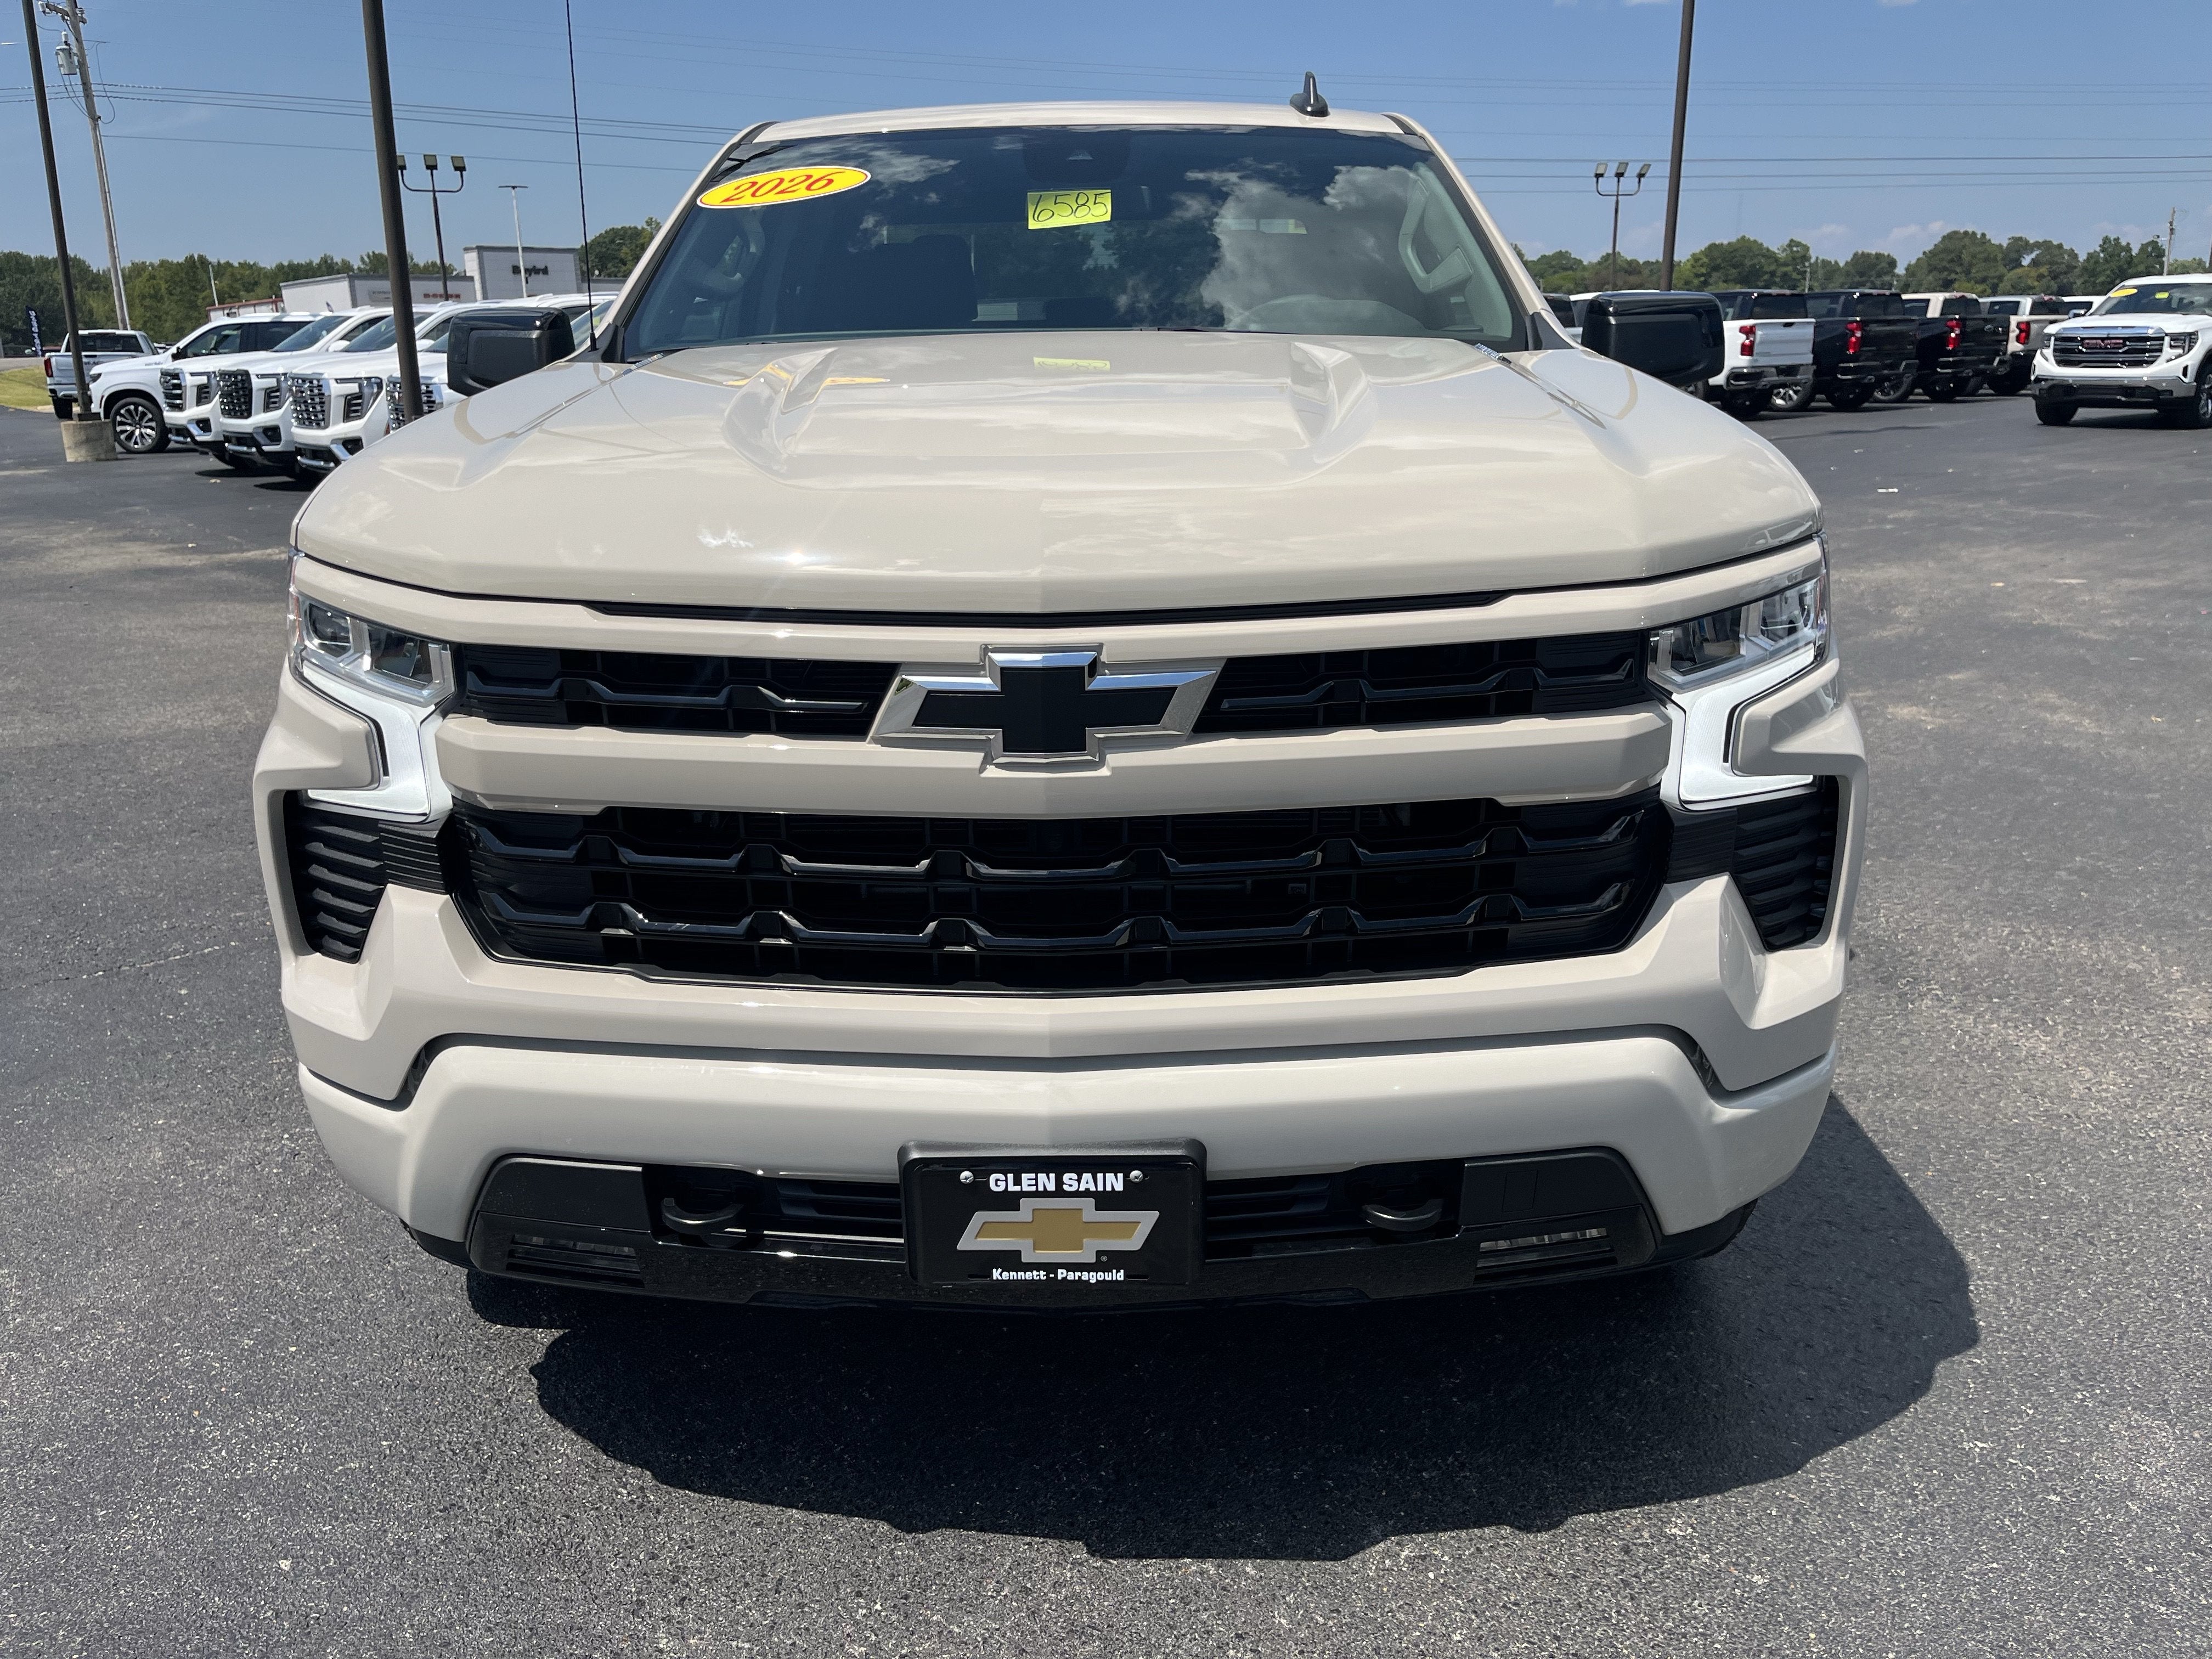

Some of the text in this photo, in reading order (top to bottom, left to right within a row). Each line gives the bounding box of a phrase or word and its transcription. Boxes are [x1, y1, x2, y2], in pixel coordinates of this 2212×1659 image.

[720, 171, 845, 204] 2026
[1032, 191, 1111, 222] 6585
[989, 1173, 1124, 1191] GLEN SAIN
[992, 1268, 1047, 1281] Kennett
[1058, 1268, 1124, 1283] Paragould
